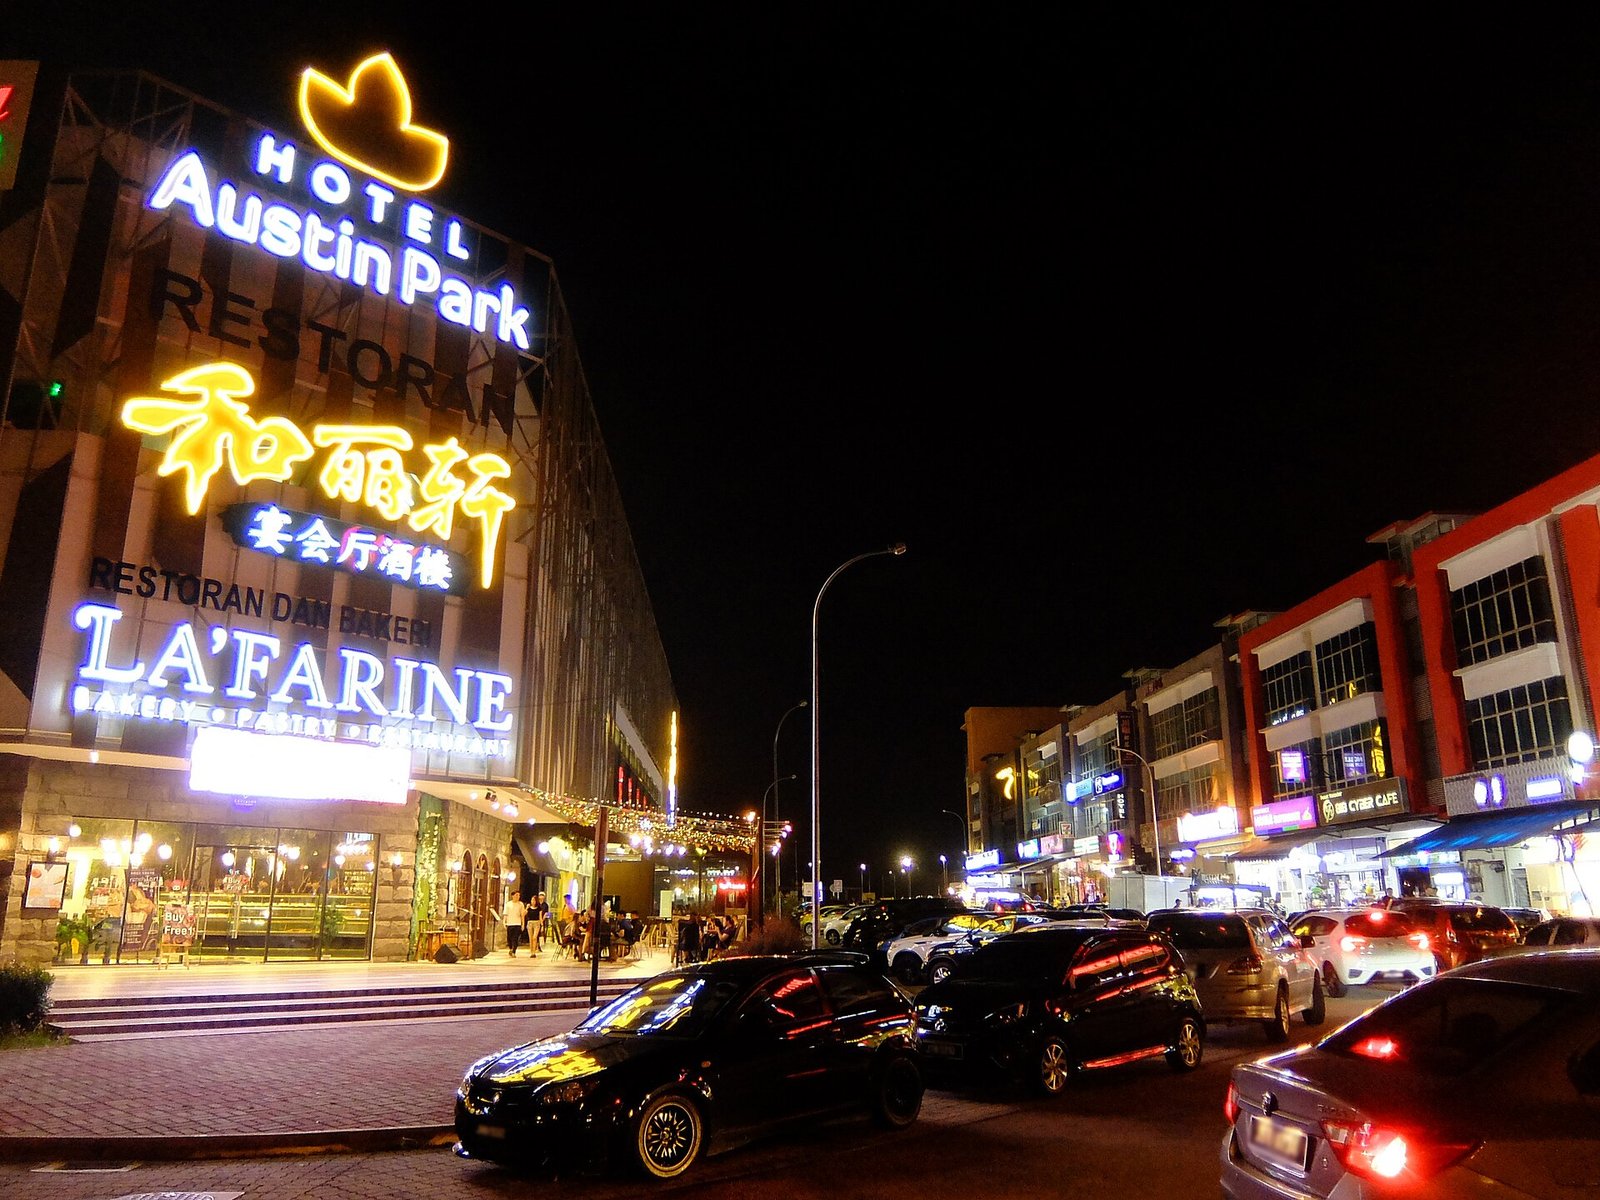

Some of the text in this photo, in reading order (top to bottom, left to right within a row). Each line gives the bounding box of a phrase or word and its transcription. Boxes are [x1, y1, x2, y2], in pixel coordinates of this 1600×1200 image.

[256, 132, 471, 262] HOTEL
[148, 150, 531, 350] Austin Park
[158, 266, 516, 435] RESTORAN
[89, 557, 264, 618] RESTORAN
[271, 593, 332, 631] DAN
[74, 685, 196, 722] BAKERY
[236, 707, 337, 739] PASTRY
[1375, 792, 1399, 807] CAFE
[164, 912, 185, 924] Buy
